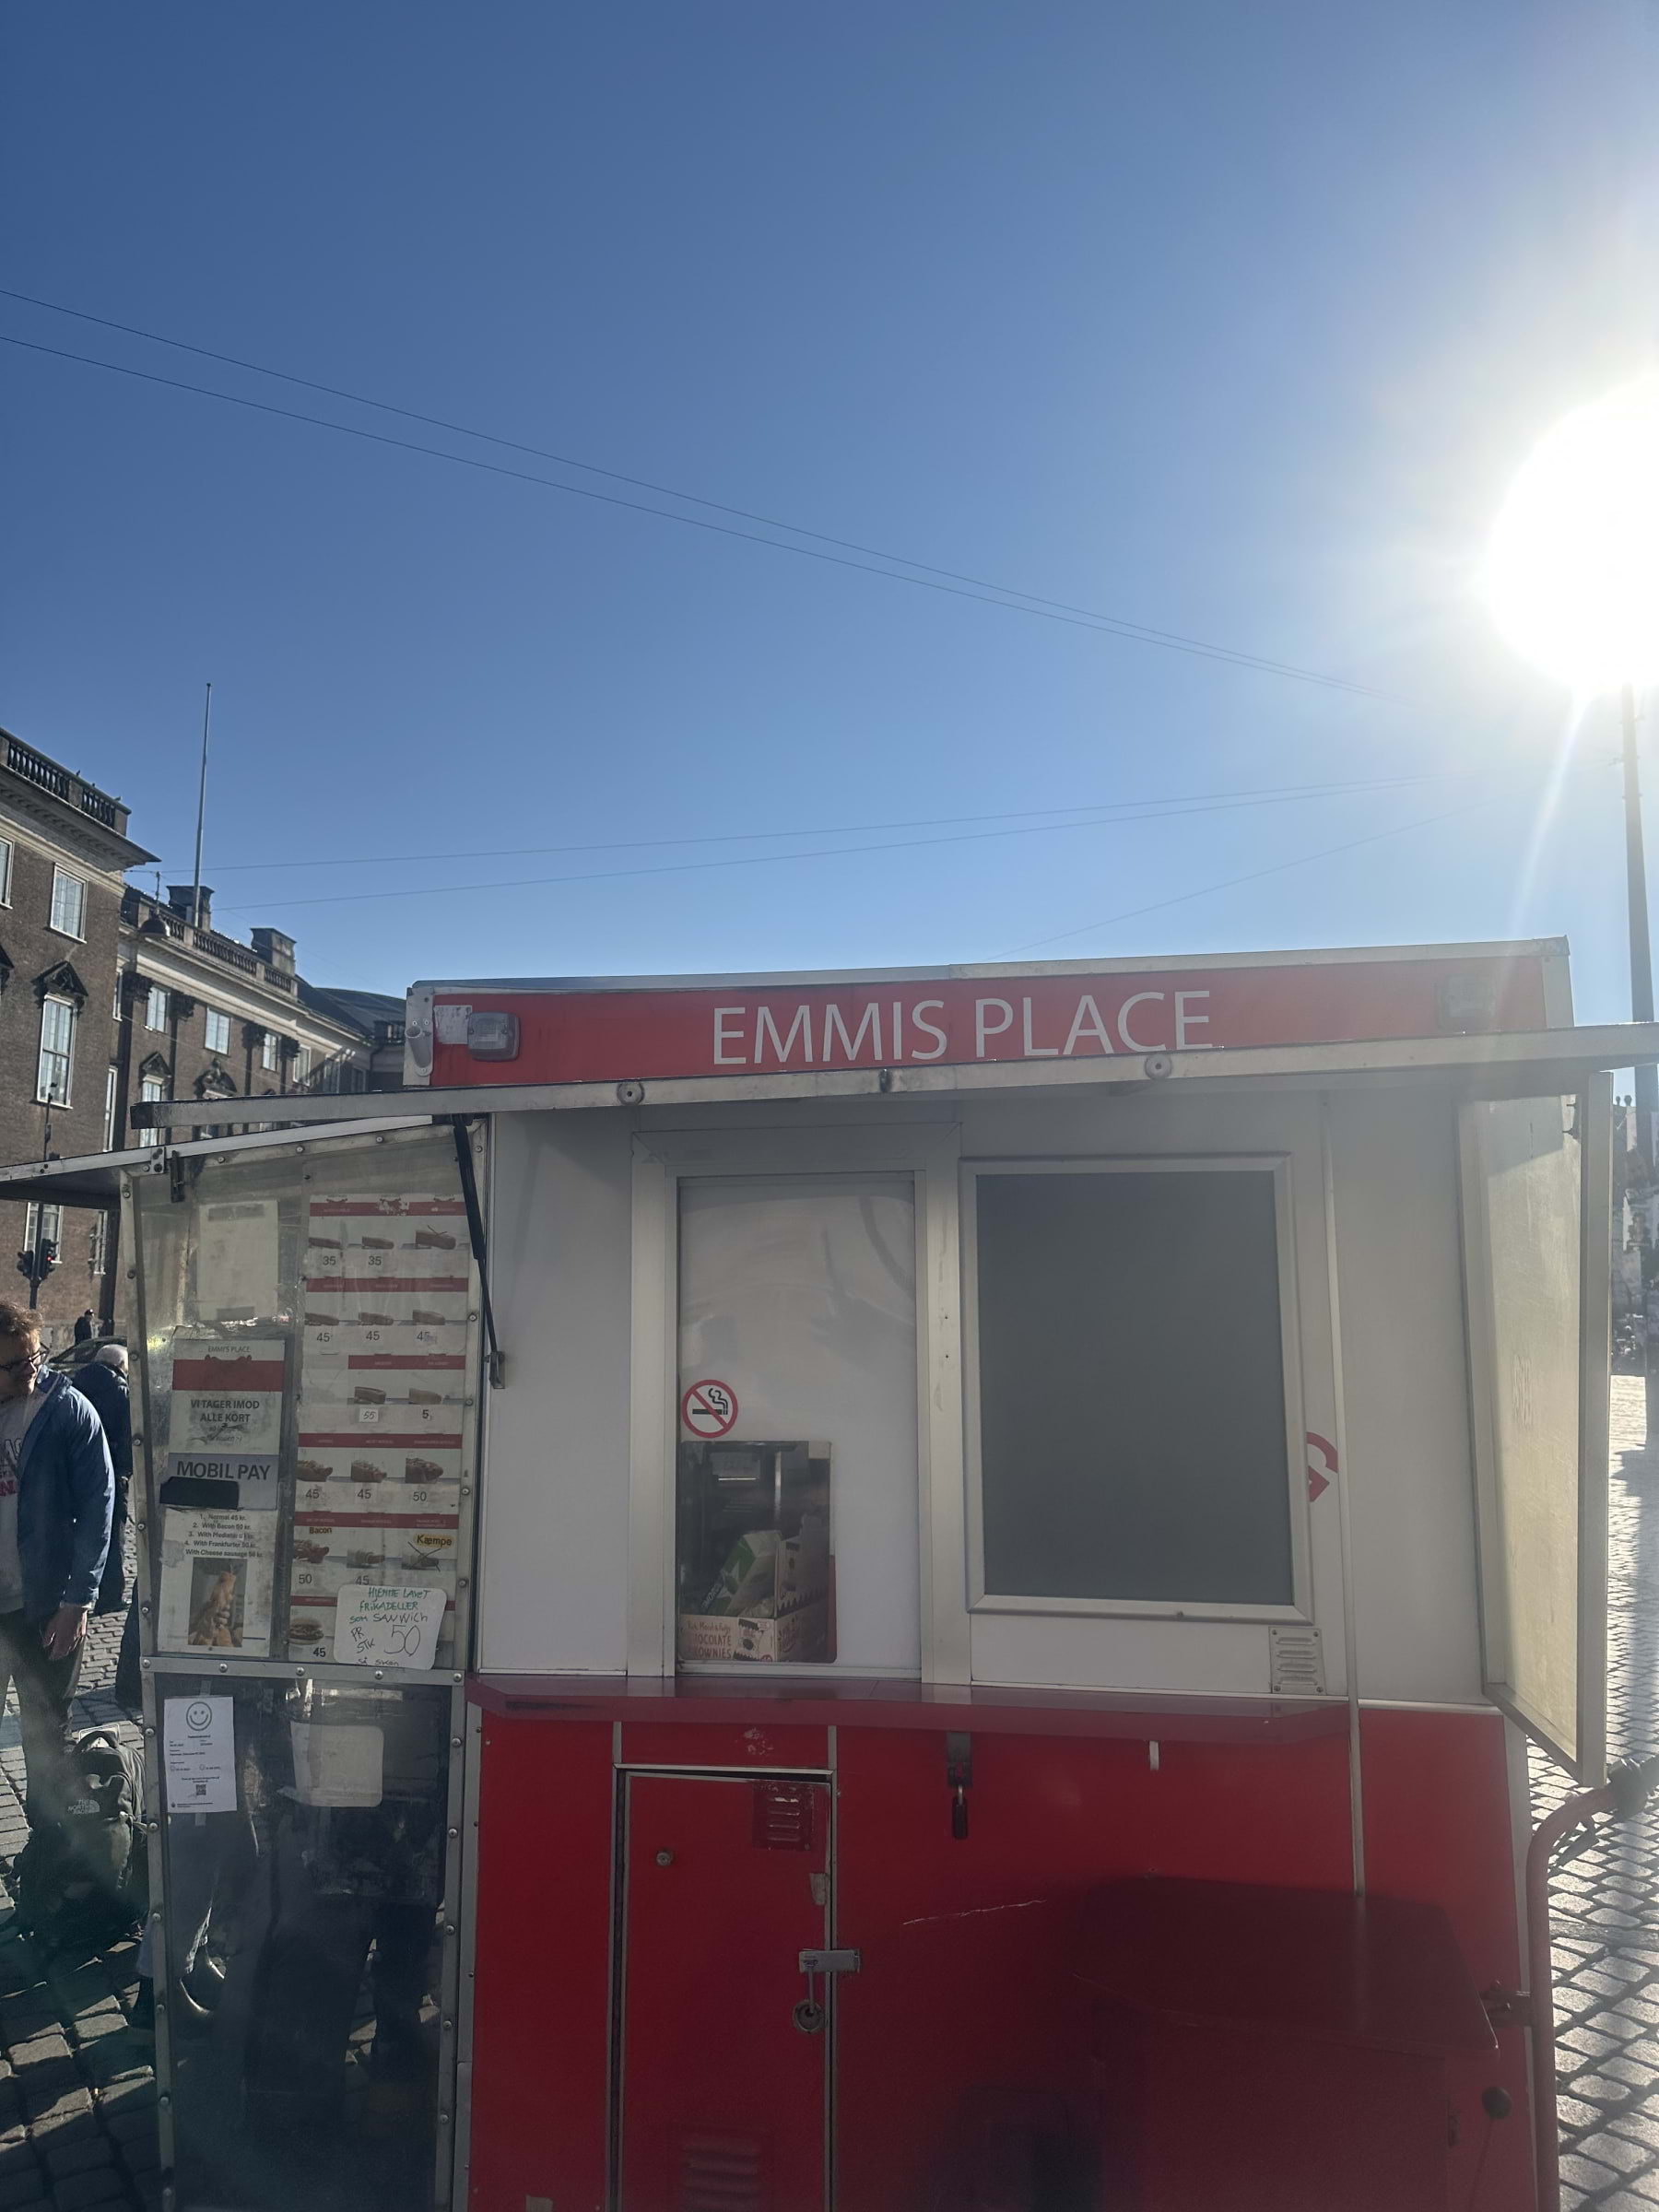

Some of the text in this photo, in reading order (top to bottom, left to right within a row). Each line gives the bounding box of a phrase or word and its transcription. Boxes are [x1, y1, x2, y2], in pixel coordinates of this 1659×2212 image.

[713, 990, 1214, 1065] EMMIS PLACE
[323, 1256, 335, 1265] 35
[369, 1256, 382, 1265] 35
[317, 1333, 330, 1342] 45
[366, 1331, 380, 1341] 45
[191, 1399, 260, 1409] VI TAGER IMOD
[200, 1413, 251, 1422] ALLE KORT
[177, 1461, 271, 1480] MOBIL PAY
[306, 1489, 319, 1500] 45
[358, 1489, 371, 1500] 45
[413, 1491, 427, 1501] 50
[417, 1534, 453, 1547] Kæmpe
[299, 1573, 312, 1584] 50
[356, 1575, 370, 1585] 45
[383, 1624, 421, 1657] 50
[312, 1647, 326, 1657] 45
